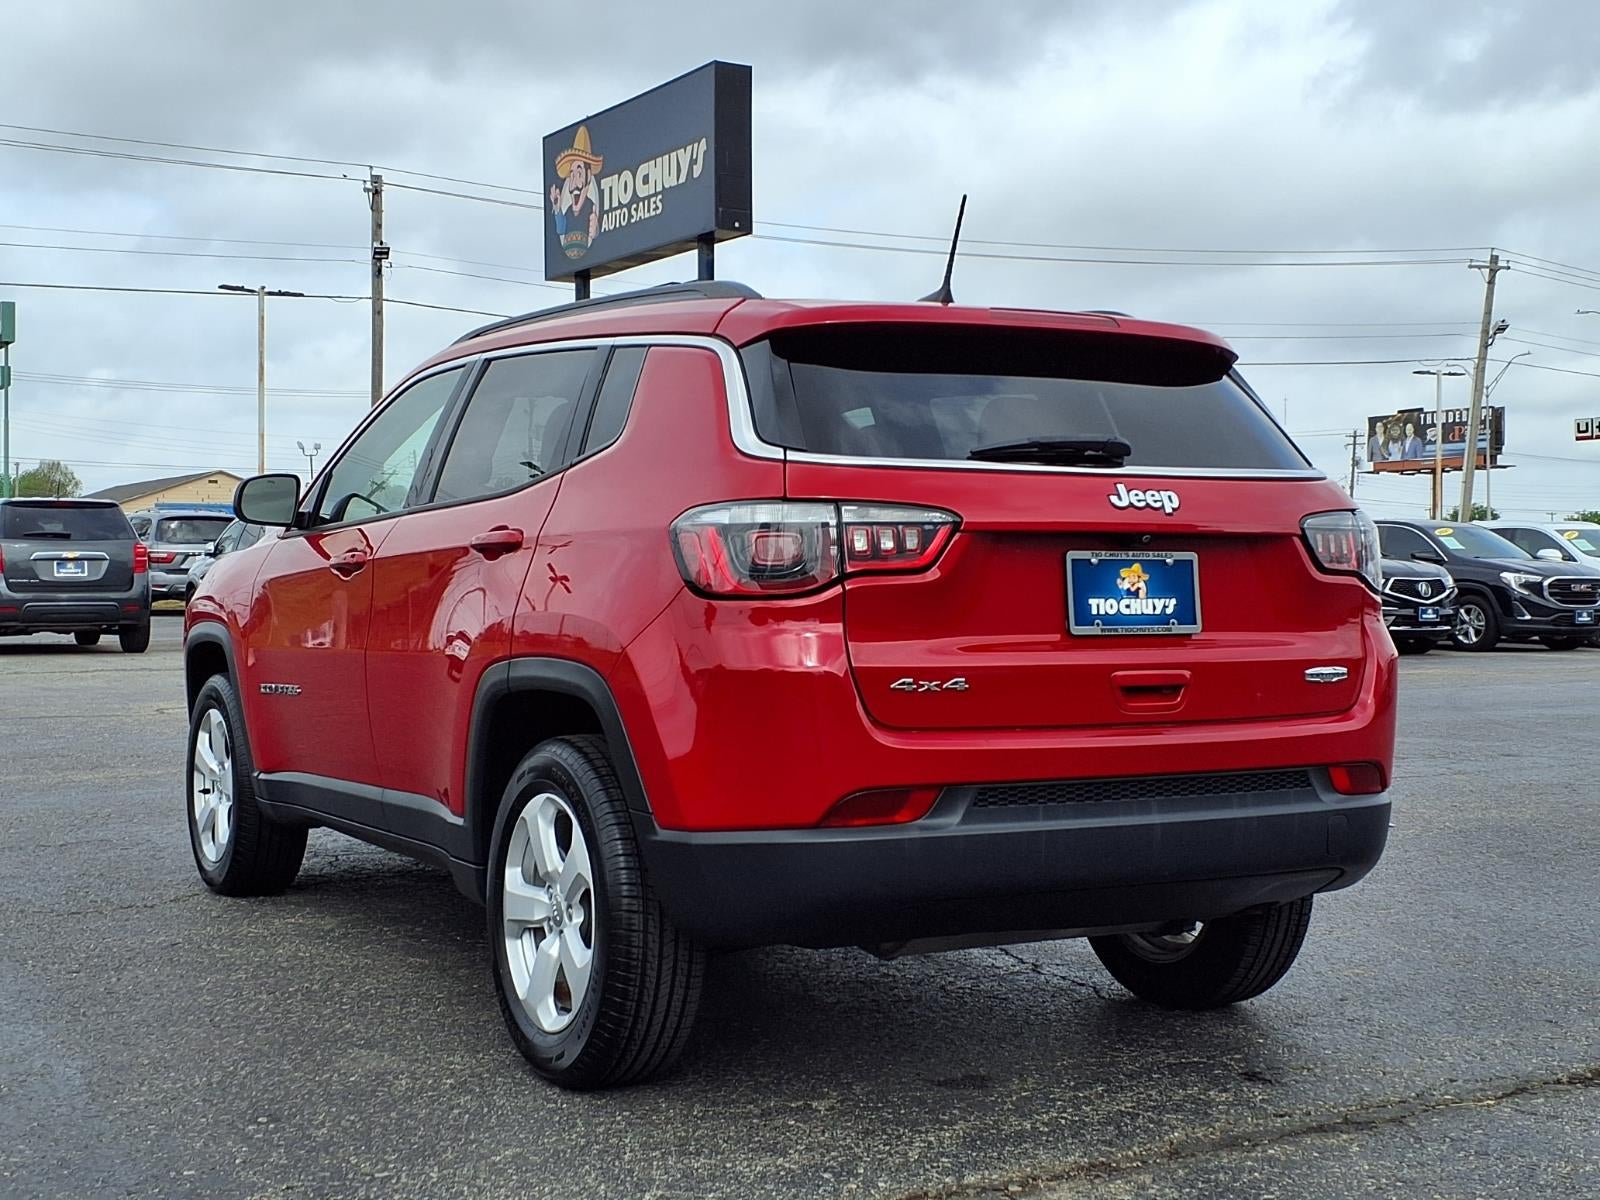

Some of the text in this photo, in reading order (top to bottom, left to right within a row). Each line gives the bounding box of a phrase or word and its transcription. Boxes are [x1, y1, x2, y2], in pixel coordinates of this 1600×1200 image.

[601, 137, 707, 211] TIO CHUY'S
[601, 194, 663, 233] AUTO SALES
[1108, 483, 1180, 515] Jeep
[1090, 551, 1103, 559] TIO
[1132, 551, 1151, 559] AUTO
[1152, 551, 1175, 560] SALES
